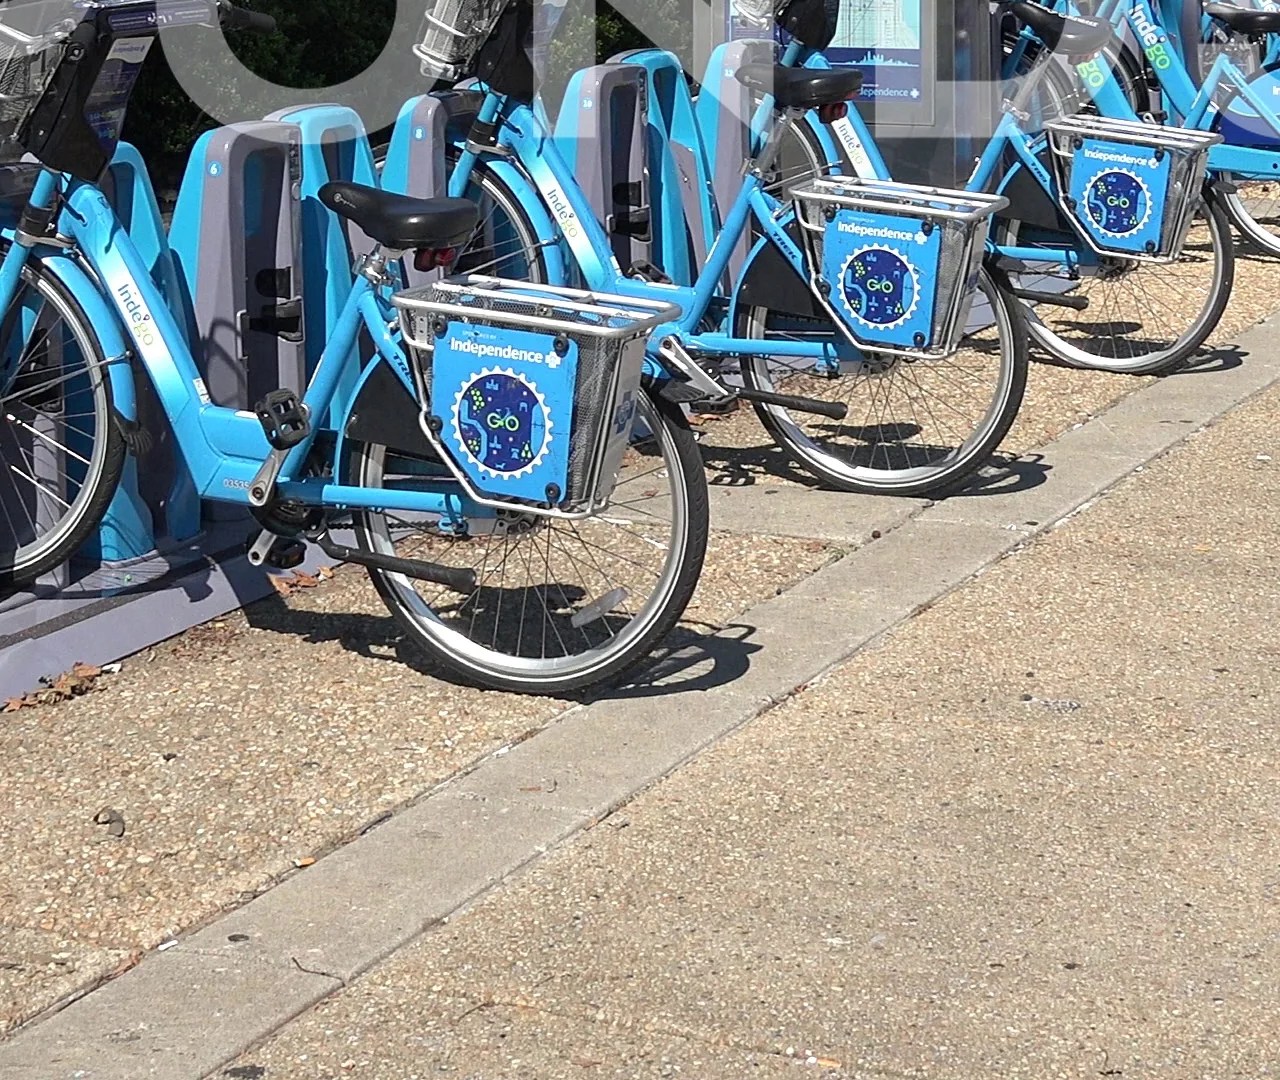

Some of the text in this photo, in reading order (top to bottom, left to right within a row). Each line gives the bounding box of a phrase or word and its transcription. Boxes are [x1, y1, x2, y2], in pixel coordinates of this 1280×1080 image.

[1128, 4, 1170, 69] Indego
[857, 86, 909, 97] dependence
[210, 163, 218, 175] 6
[1084, 148, 1148, 166] Independence
[546, 189, 578, 238] Indego
[837, 221, 913, 241] Independence
[773, 231, 798, 259] TREK
[117, 283, 154, 347] Indego
[450, 337, 544, 364] Independence
